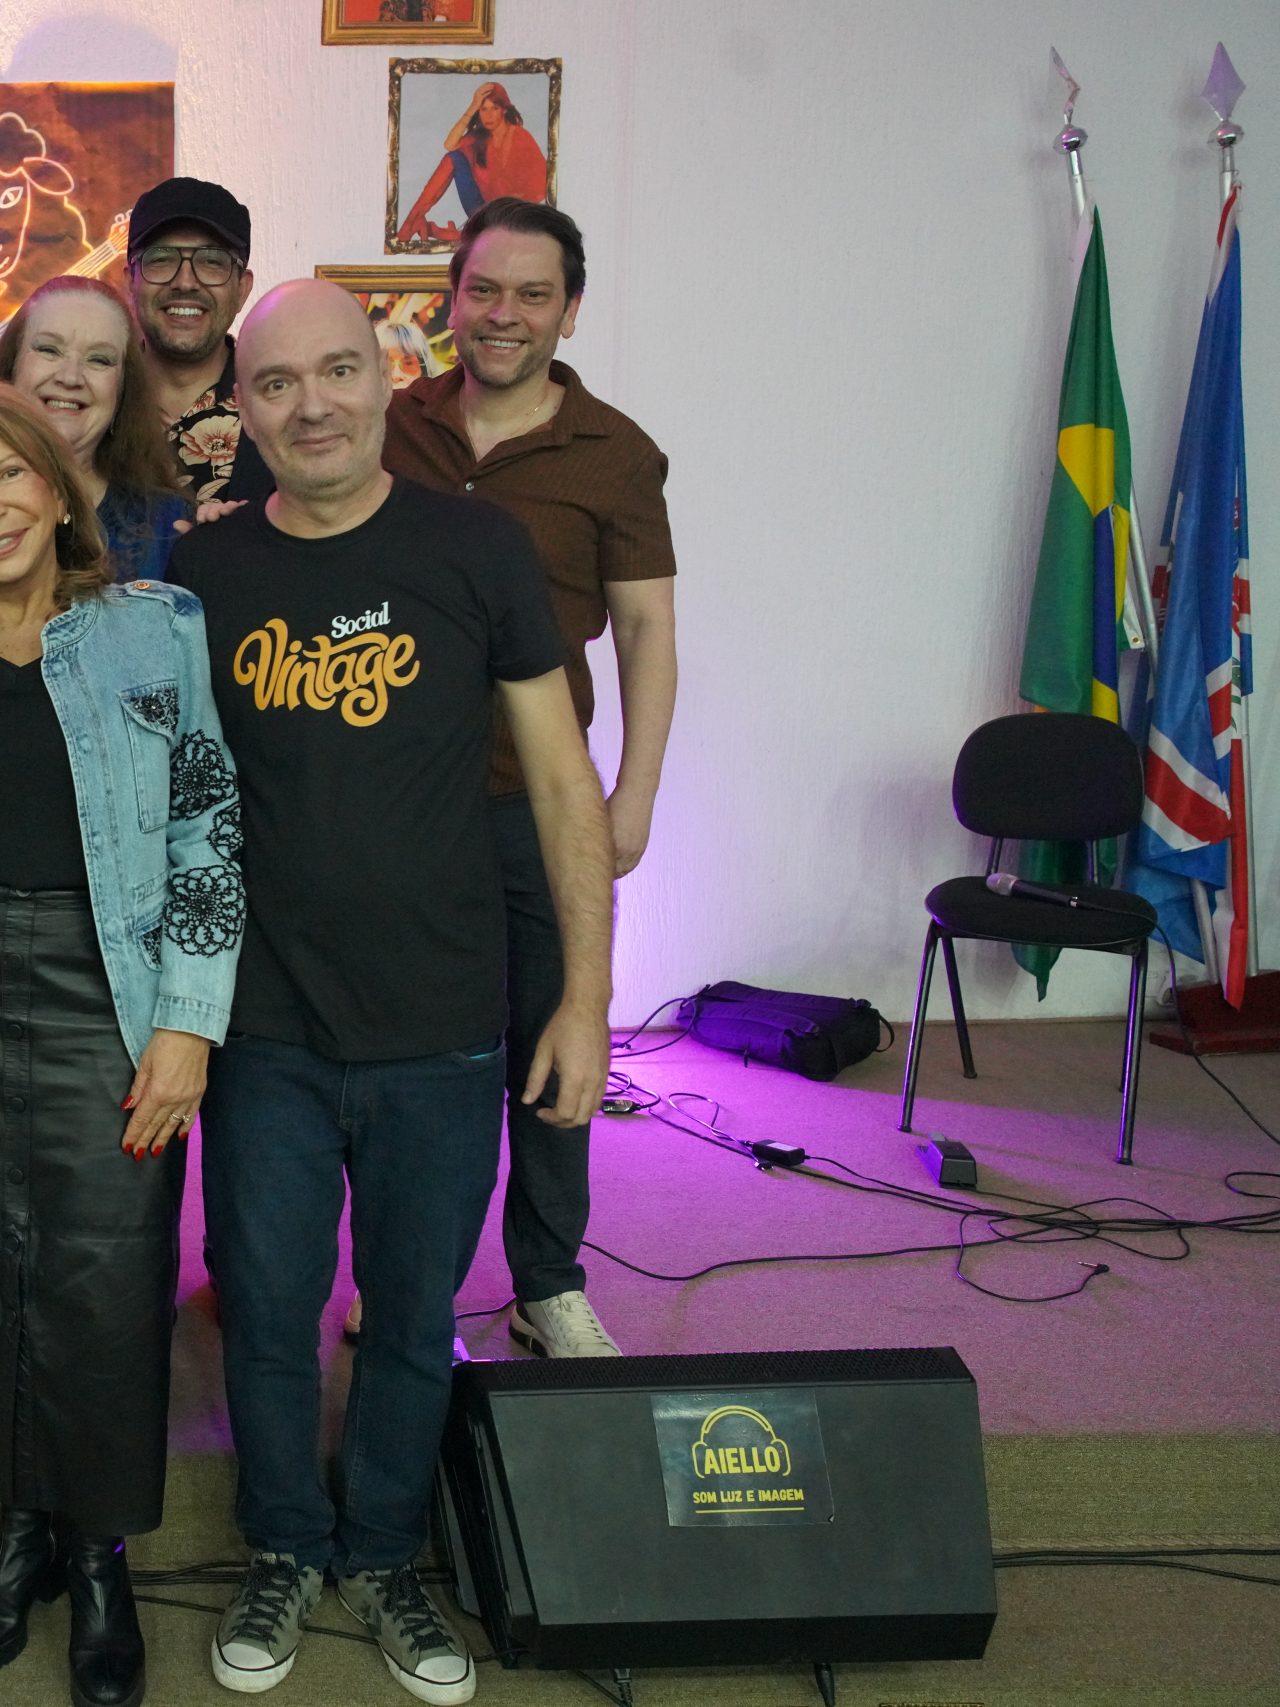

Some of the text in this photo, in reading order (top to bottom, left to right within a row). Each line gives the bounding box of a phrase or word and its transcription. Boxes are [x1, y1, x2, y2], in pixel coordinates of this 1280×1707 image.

[331, 601, 391, 639] Social
[233, 617, 420, 727] Vintage
[704, 1446, 781, 1475] AIELLO
[692, 1488, 805, 1504] SOM LUZ E IMAGEM
